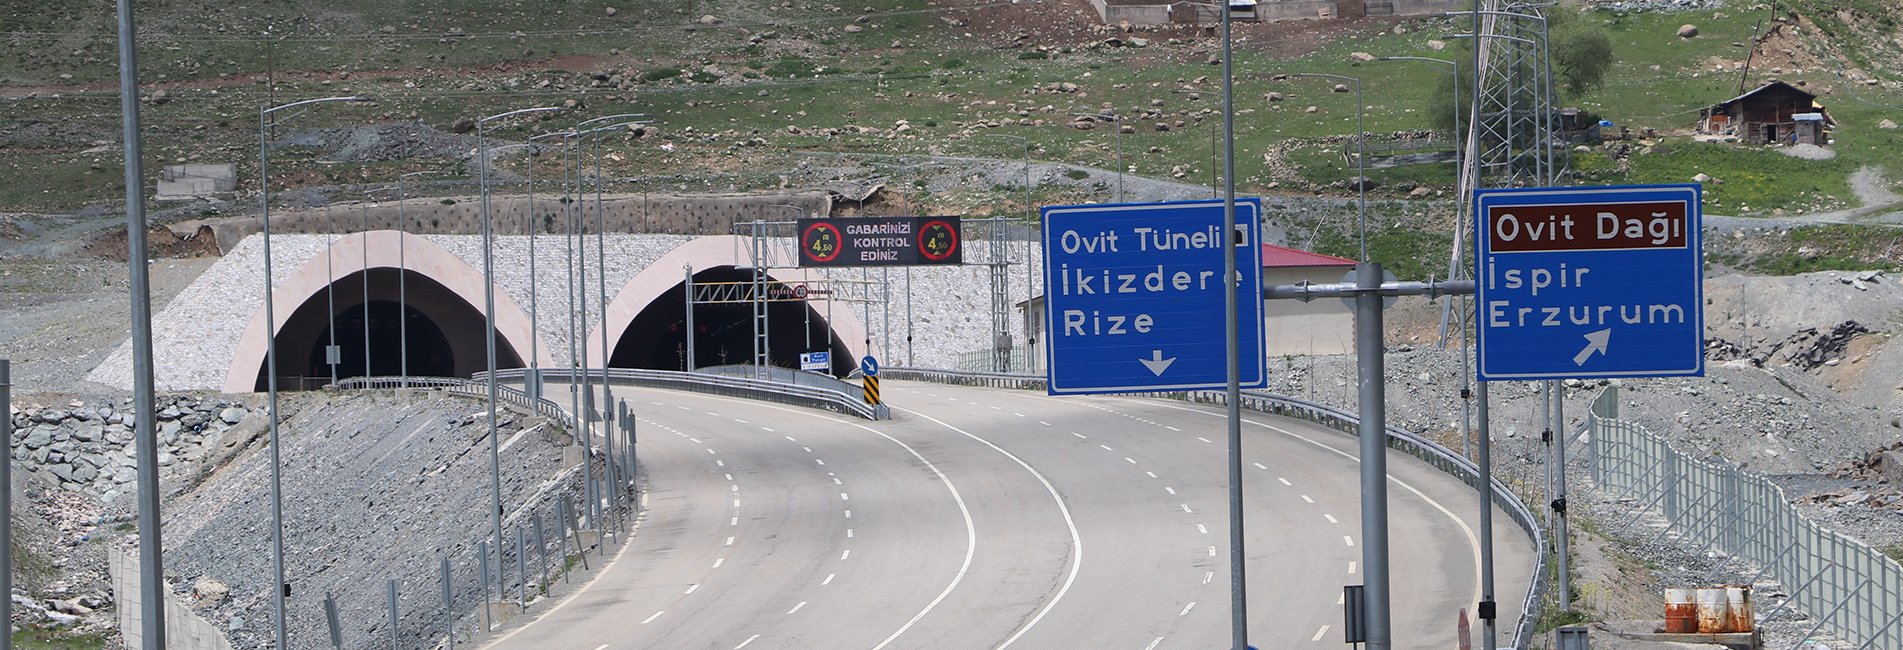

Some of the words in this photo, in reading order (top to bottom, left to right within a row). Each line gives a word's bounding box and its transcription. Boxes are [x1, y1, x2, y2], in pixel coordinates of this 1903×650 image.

[846, 222, 911, 235] GABARİNİZİ
[1060, 230, 1118, 254] Ovit
[1134, 225, 1221, 251] Tüneli
[1496, 213, 1575, 242] Ovit
[1596, 211, 1680, 245] Dağı
[853, 237, 911, 248] KONTROL
[860, 250, 898, 261] EDİNİZ
[1488, 256, 1590, 296] İspir
[1063, 309, 1154, 337] Rize
[1489, 300, 1685, 328] Erzurum
